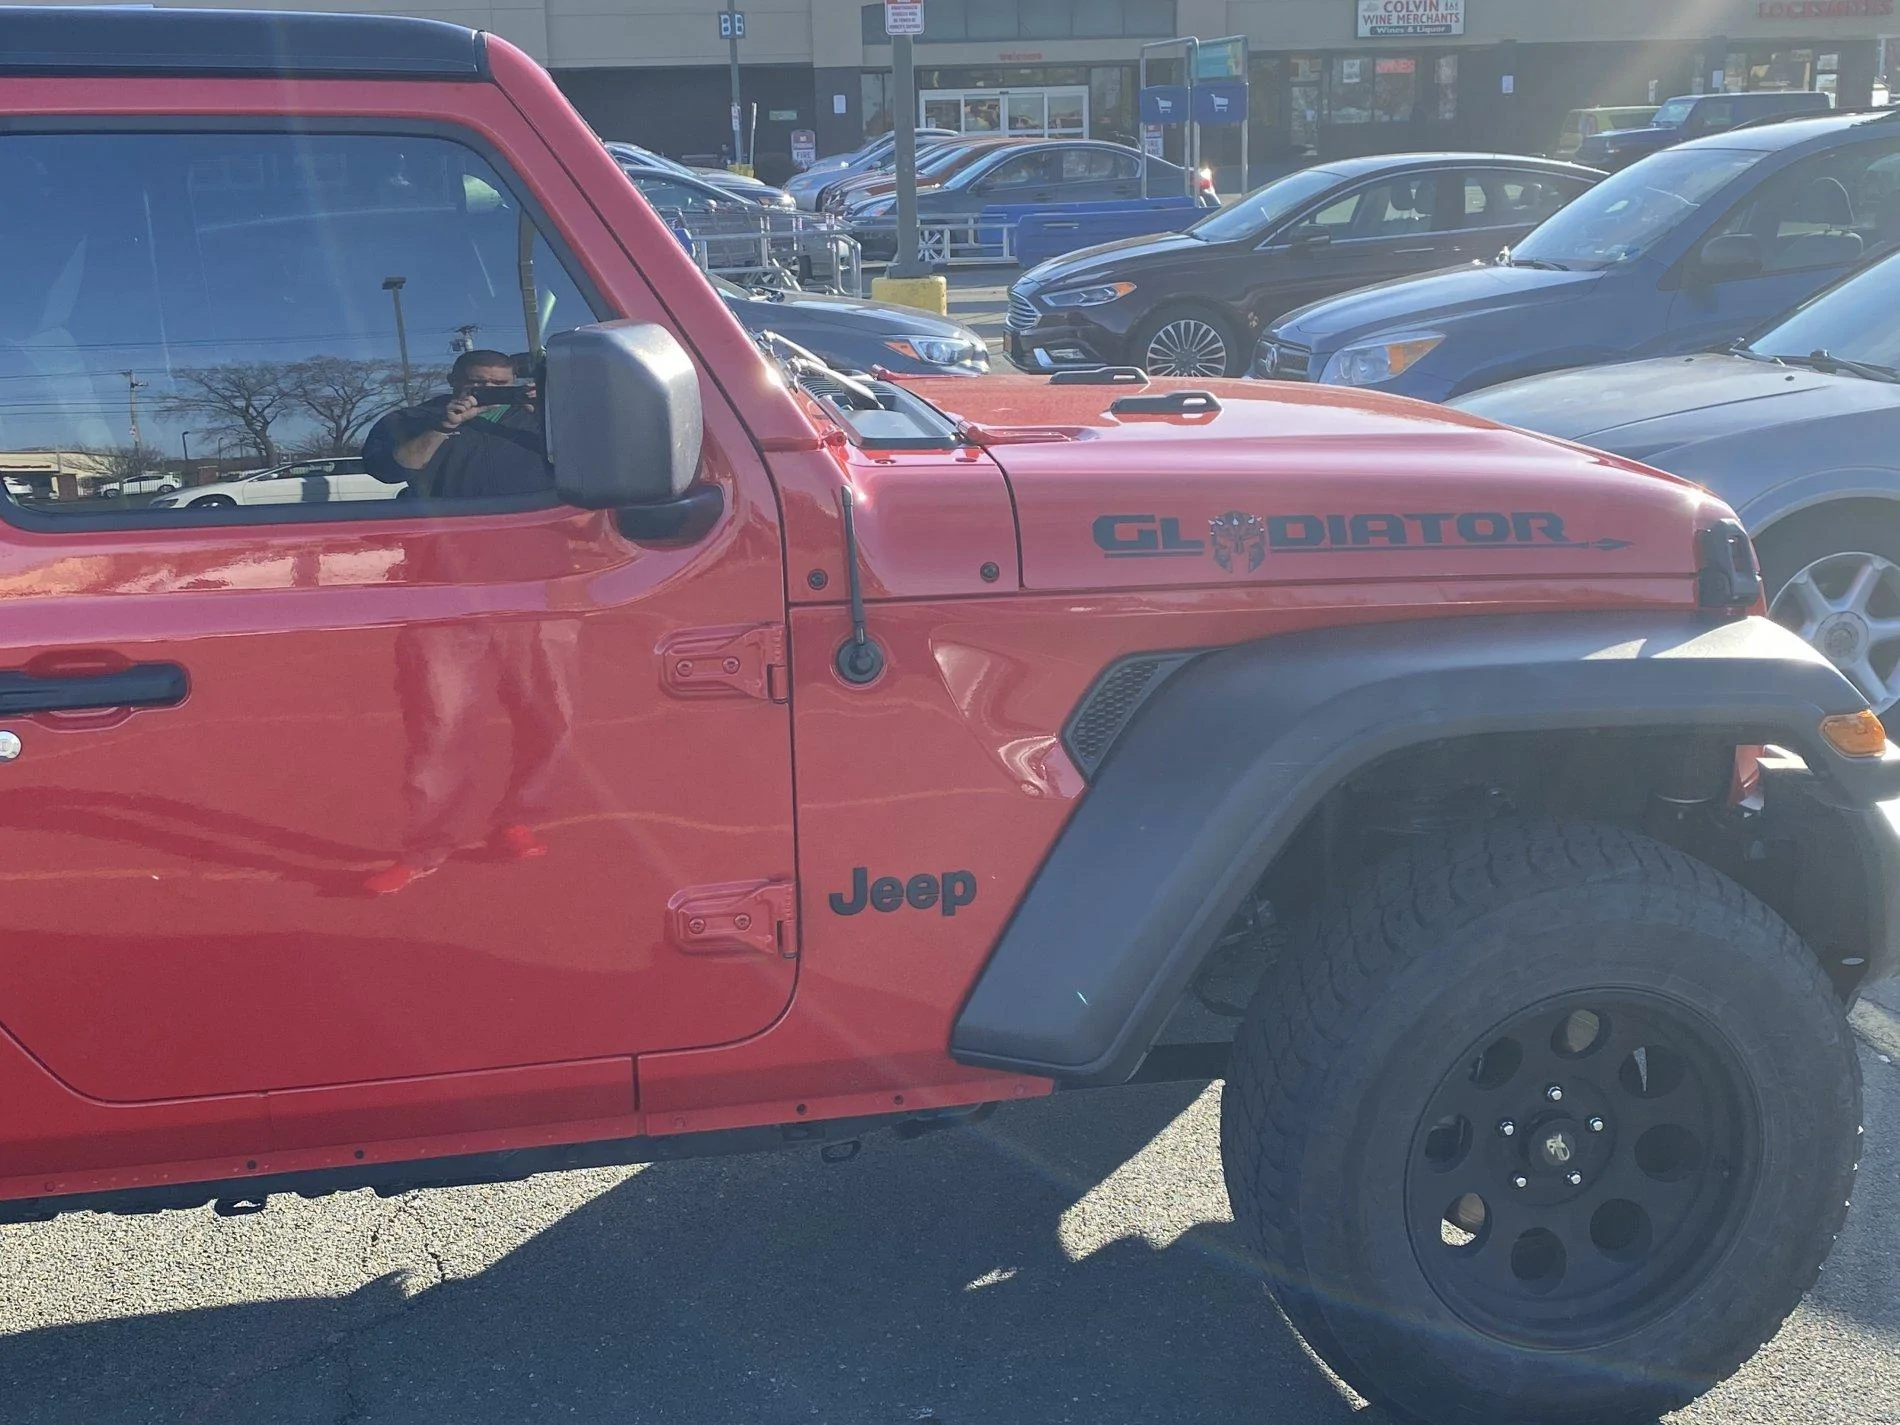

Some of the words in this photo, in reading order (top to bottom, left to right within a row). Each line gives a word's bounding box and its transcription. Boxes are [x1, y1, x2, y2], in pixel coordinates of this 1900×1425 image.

[1383, 0, 1440, 13] COLVIN
[720, 14, 744, 36] BB
[1362, 14, 1393, 26] WINE
[1396, 12, 1460, 25] MERCHANTS
[1376, 26, 1404, 34] Wines
[1416, 25, 1446, 35] Liquor
[796, 151, 812, 160] FIRE
[829, 867, 977, 917] Jeep
